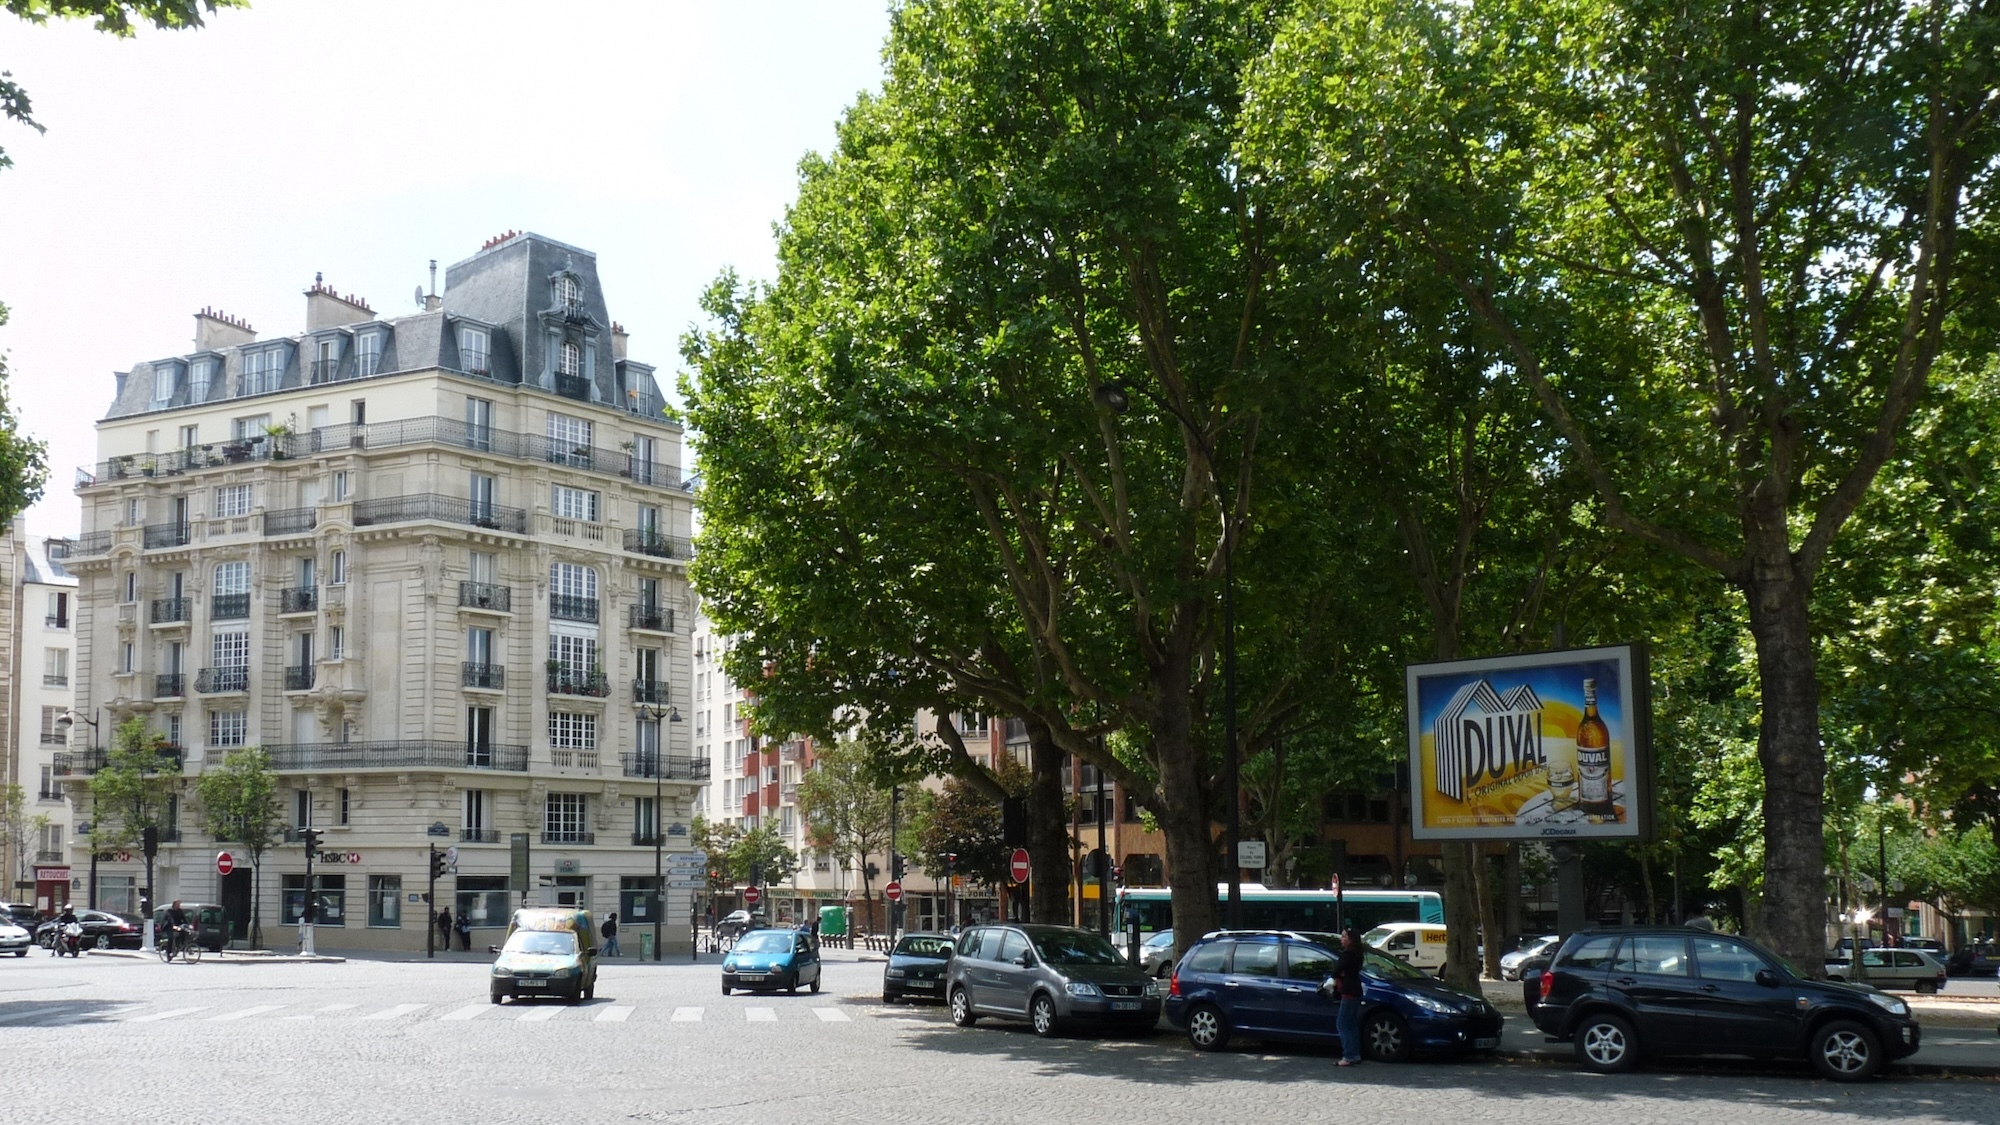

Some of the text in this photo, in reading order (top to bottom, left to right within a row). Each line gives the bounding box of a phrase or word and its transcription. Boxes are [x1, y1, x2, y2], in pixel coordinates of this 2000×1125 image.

[1463, 713, 1547, 788] DUVAL
[1577, 751, 1608, 763] DUVAL
[1466, 776, 1513, 801] L'ORIGINAL
[320, 851, 347, 864] HSBC
[1426, 932, 1447, 942] Hert
